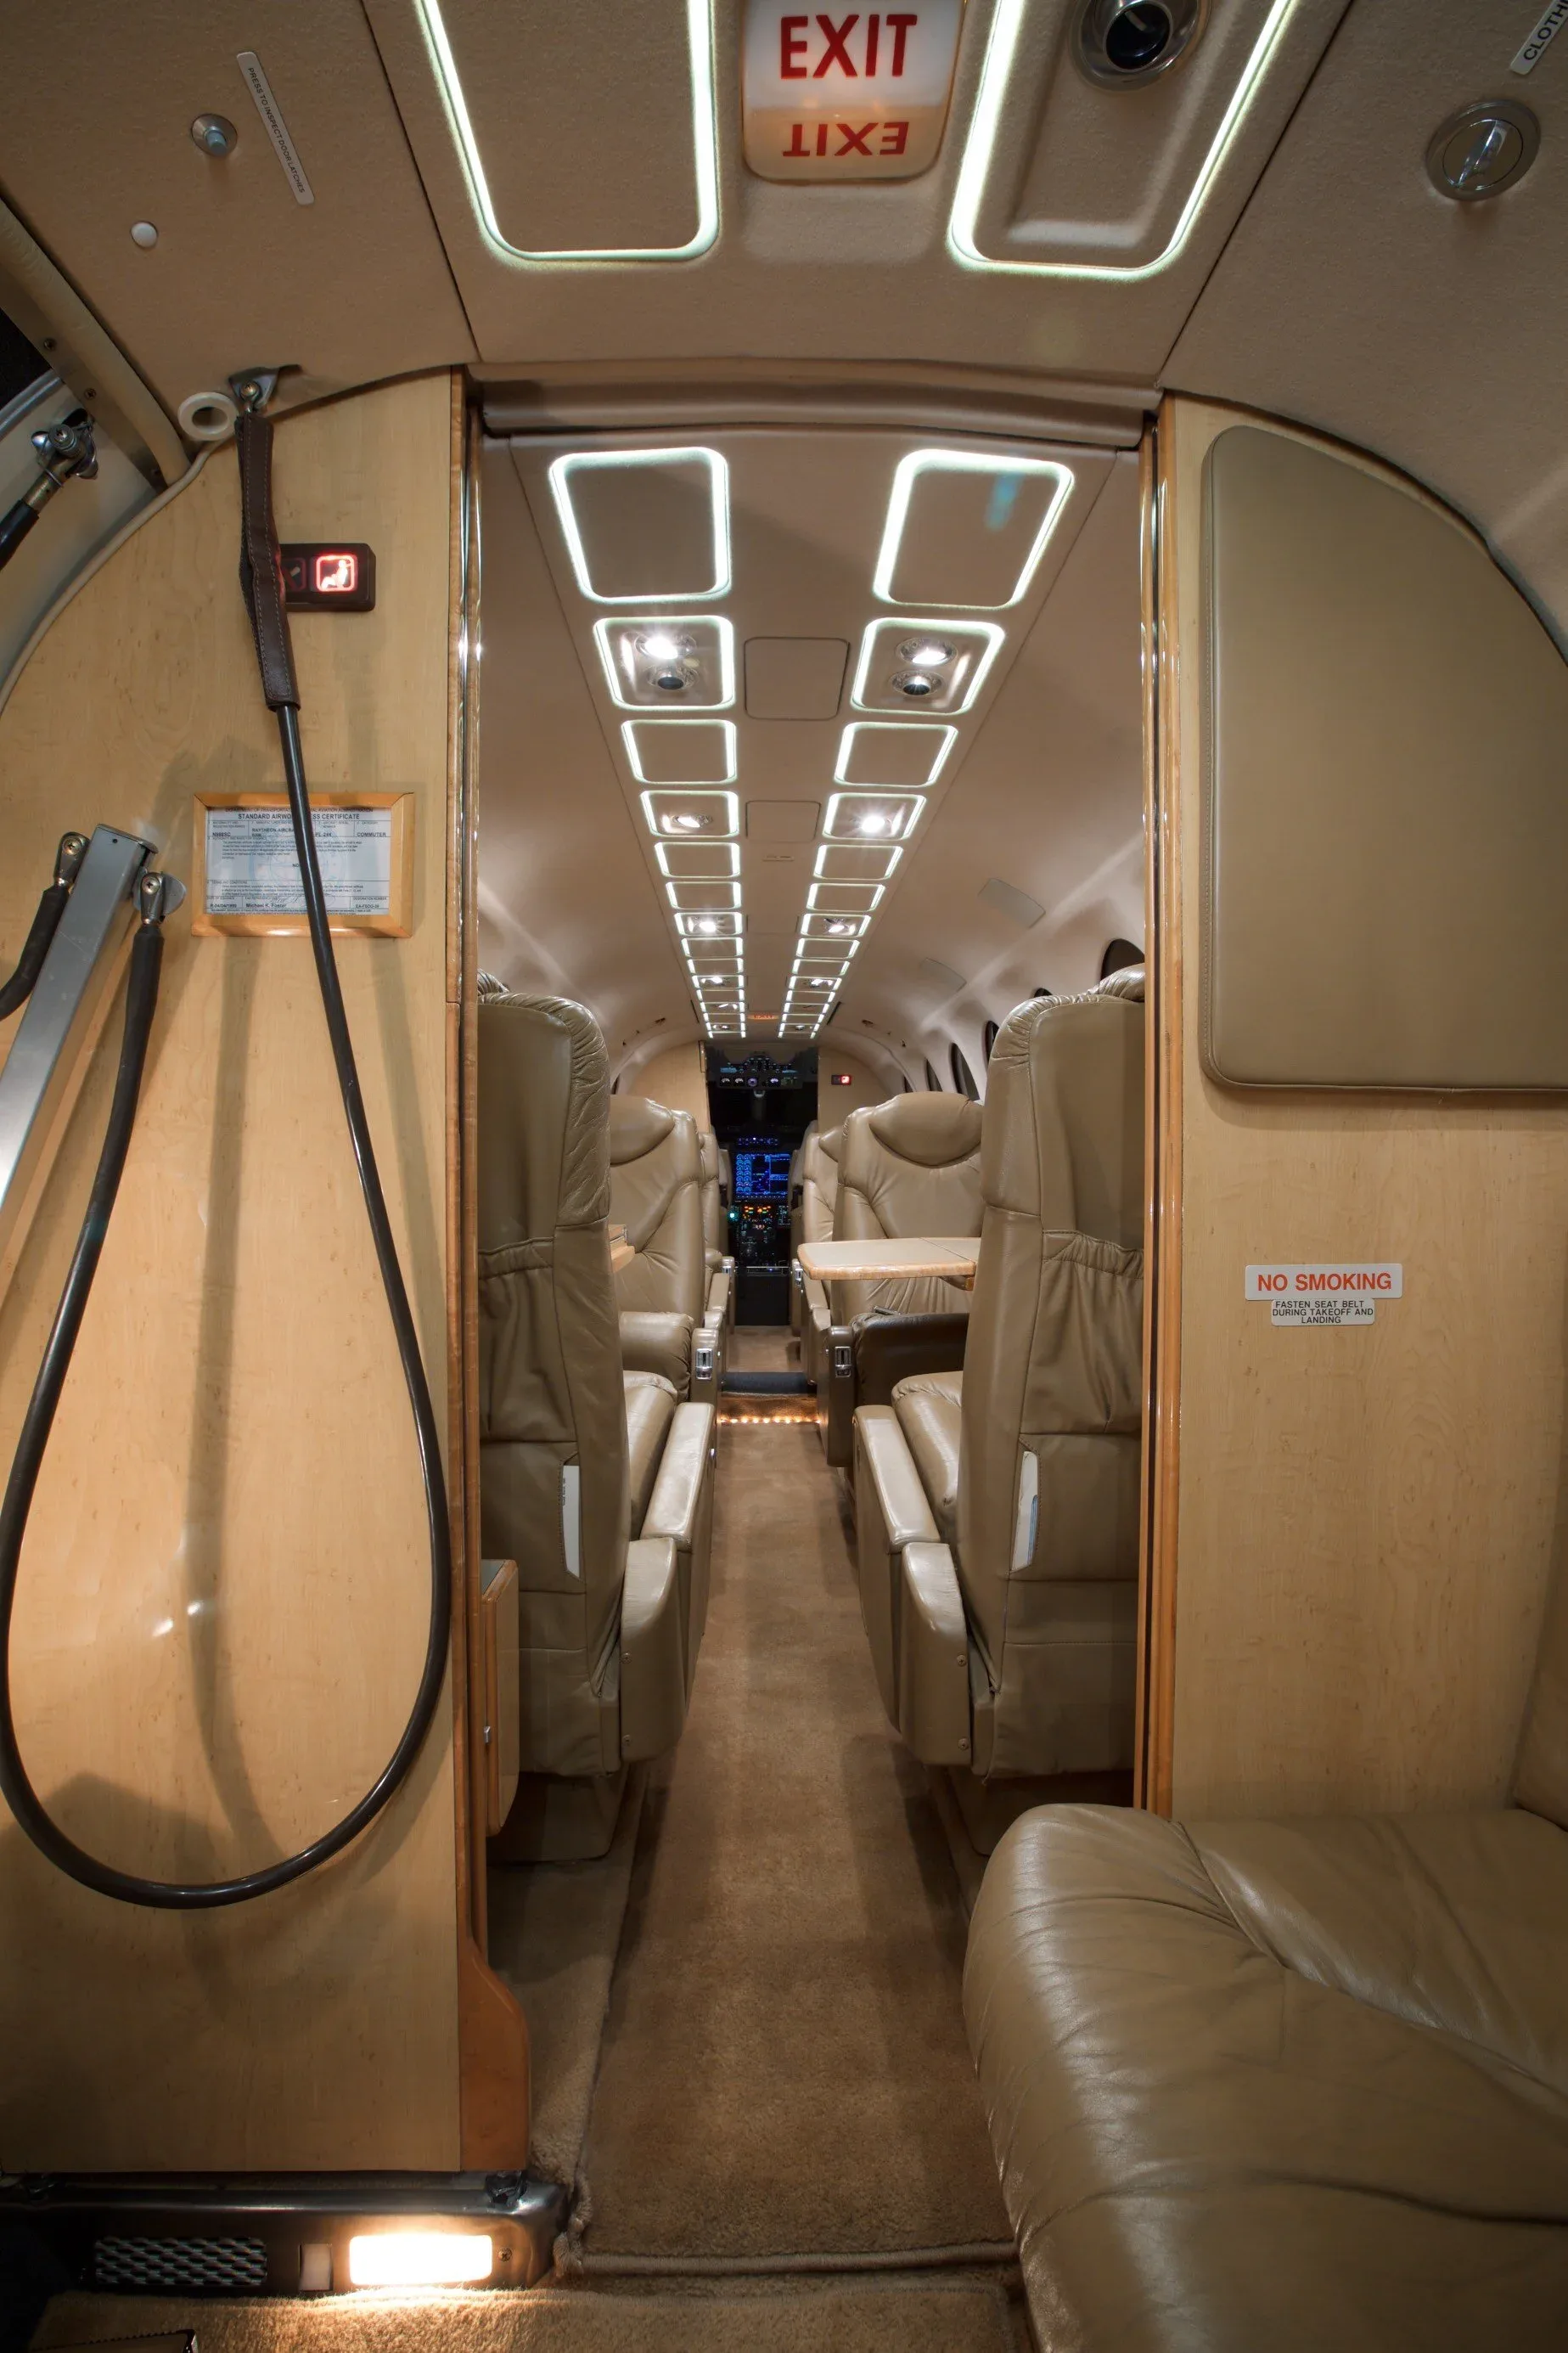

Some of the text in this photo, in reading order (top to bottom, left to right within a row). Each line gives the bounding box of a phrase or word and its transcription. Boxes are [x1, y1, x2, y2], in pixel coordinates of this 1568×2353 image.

[780, 14, 918, 79] EXIT
[1524, 0, 1568, 60] CLOTH
[248, 67, 306, 194] PRESS TO INSPECT DOOR LATCHES
[783, 121, 909, 157] EXIT
[1257, 1272, 1392, 1292] NO SMOKING
[1275, 1300, 1365, 1309] FASTEN SEAT BELT
[1310, 1308, 1352, 1316] TAKEOFF
[1355, 1308, 1374, 1316] AND
